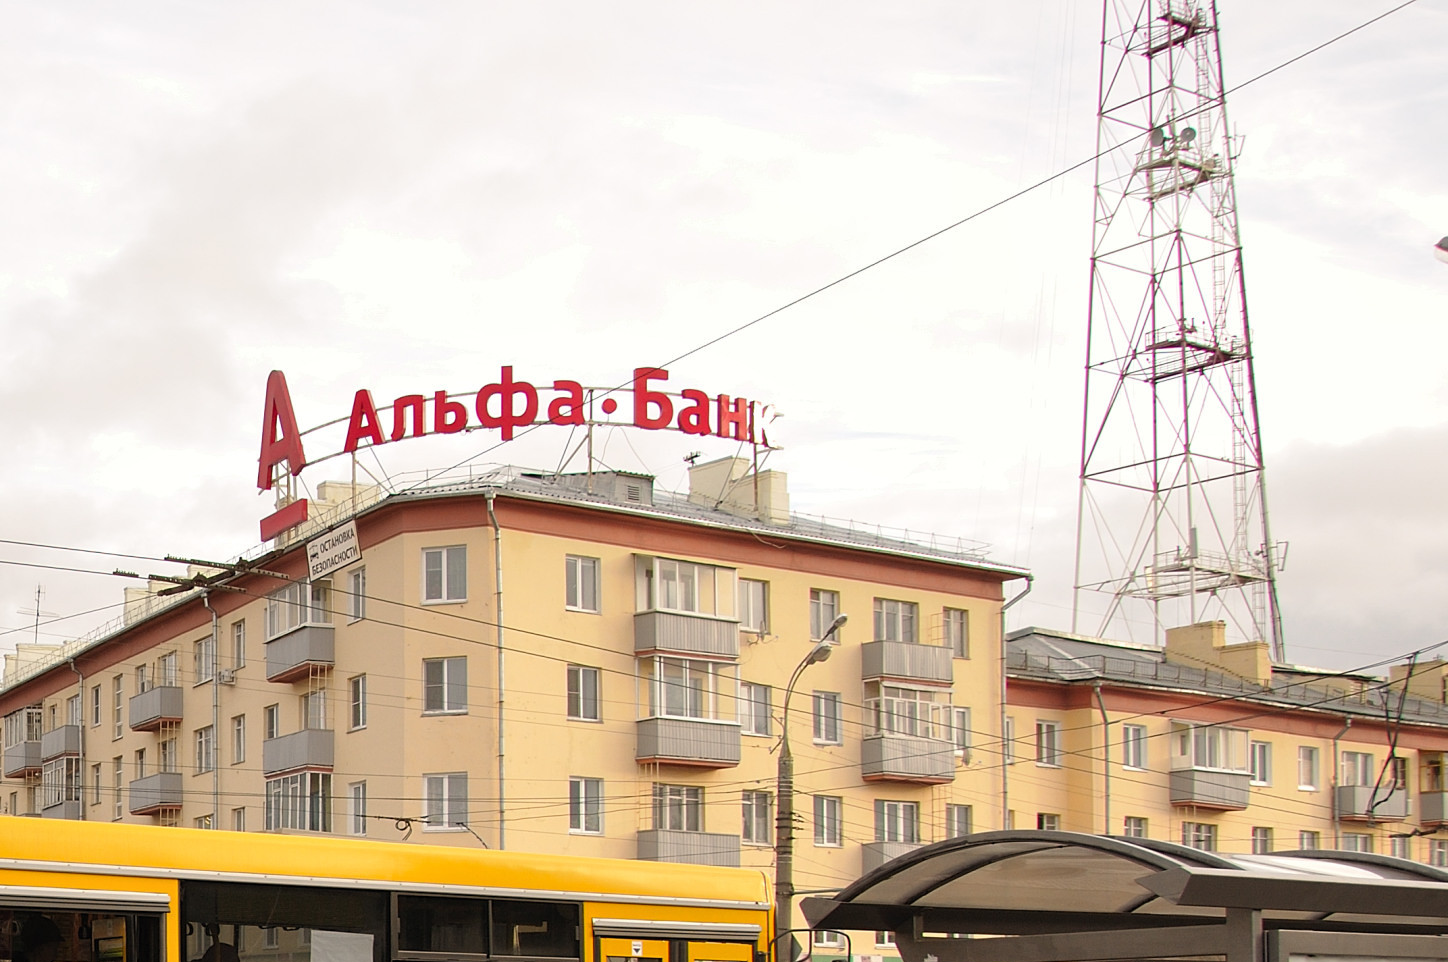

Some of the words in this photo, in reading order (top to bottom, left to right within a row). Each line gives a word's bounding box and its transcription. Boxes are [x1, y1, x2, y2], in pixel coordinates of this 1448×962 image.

[344, 366, 586, 453] Альфа
[634, 367, 778, 448] Банк
[319, 528, 355, 554] ОСТАНОВКА
[312, 545, 358, 576] БЕЗОПАСНОСТИ
